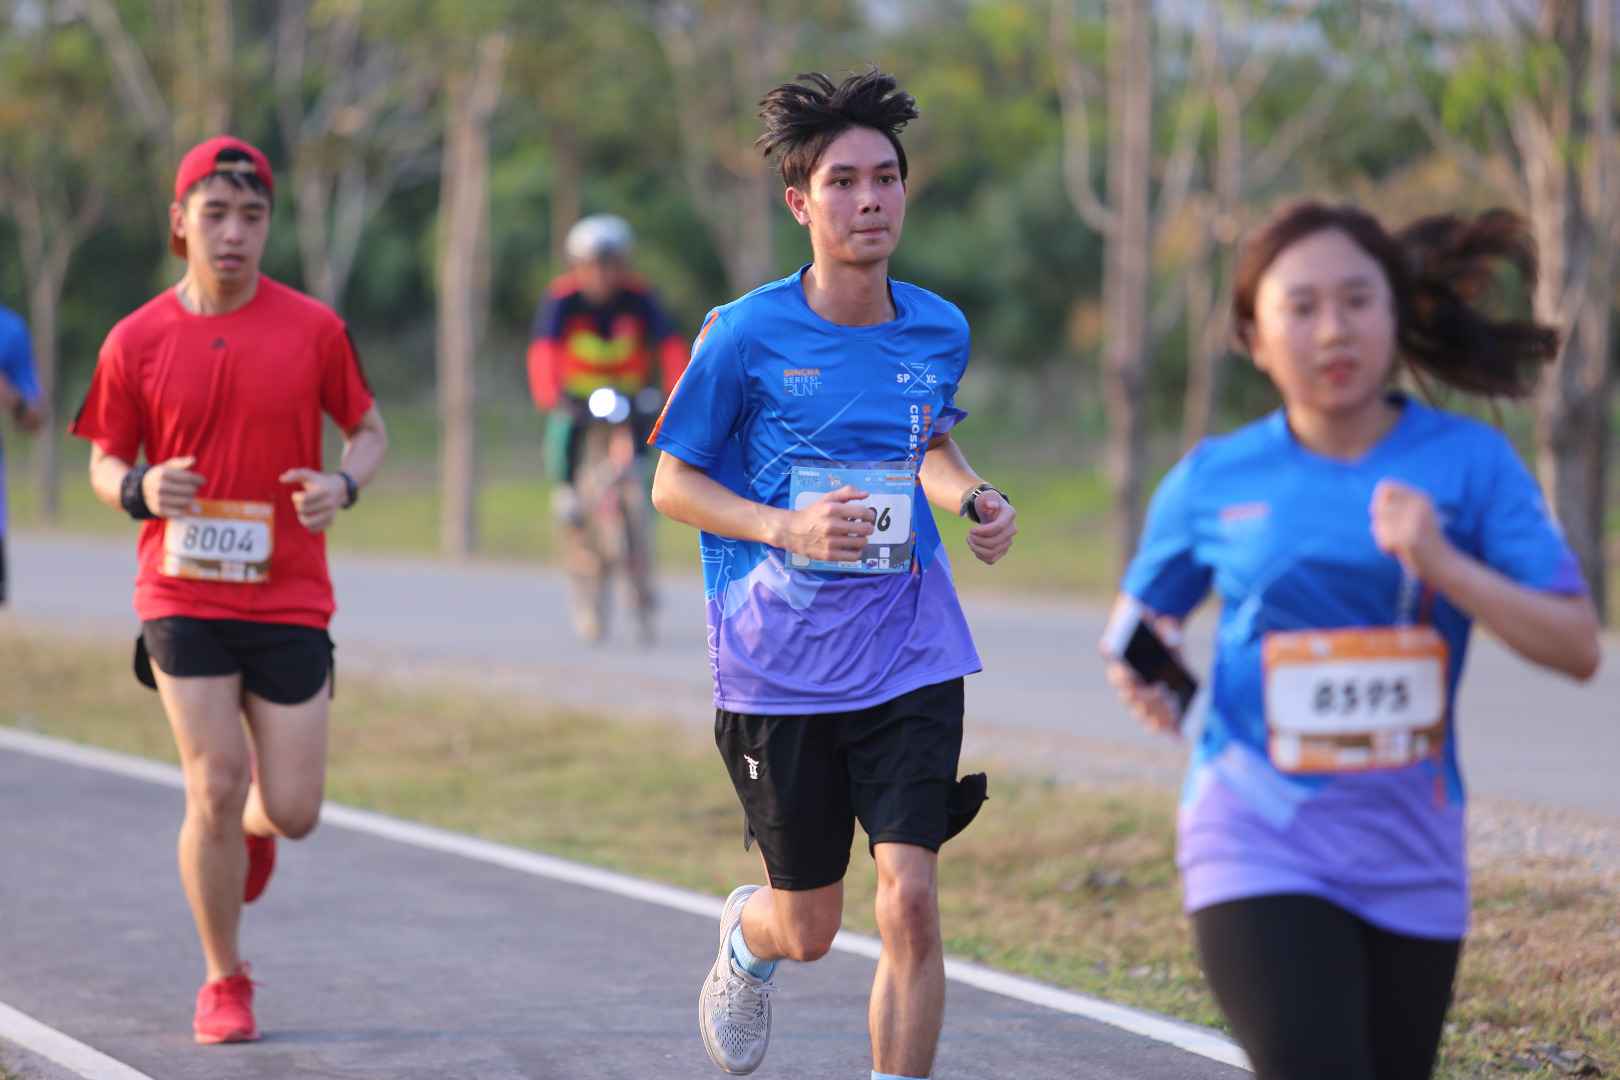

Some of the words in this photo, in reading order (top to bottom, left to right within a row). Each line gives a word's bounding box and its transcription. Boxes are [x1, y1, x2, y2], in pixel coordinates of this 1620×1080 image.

[783, 368, 820, 377] SINGHA
[897, 373, 910, 384] SP
[926, 374, 937, 384] XC
[909, 404, 920, 451] CROSS
[183, 524, 254, 554] 8004
